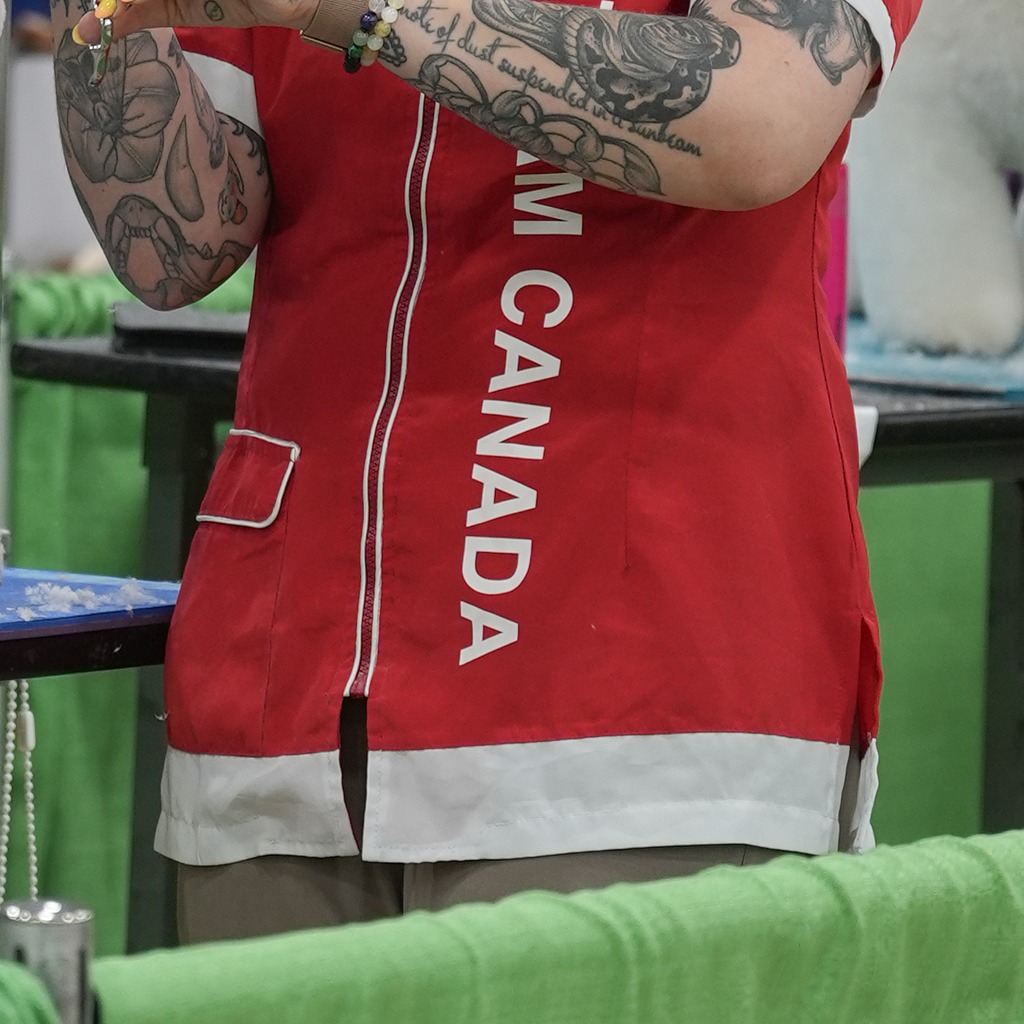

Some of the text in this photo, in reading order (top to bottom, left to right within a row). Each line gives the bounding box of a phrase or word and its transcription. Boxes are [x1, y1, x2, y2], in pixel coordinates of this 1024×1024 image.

[432, 13, 461, 54] of
[457, 21, 522, 65] dust
[497, 58, 590, 112] suspended
[592, 105, 610, 121] in
[627, 120, 703, 157] sunbeam
[458, 268, 574, 667] CANADA
